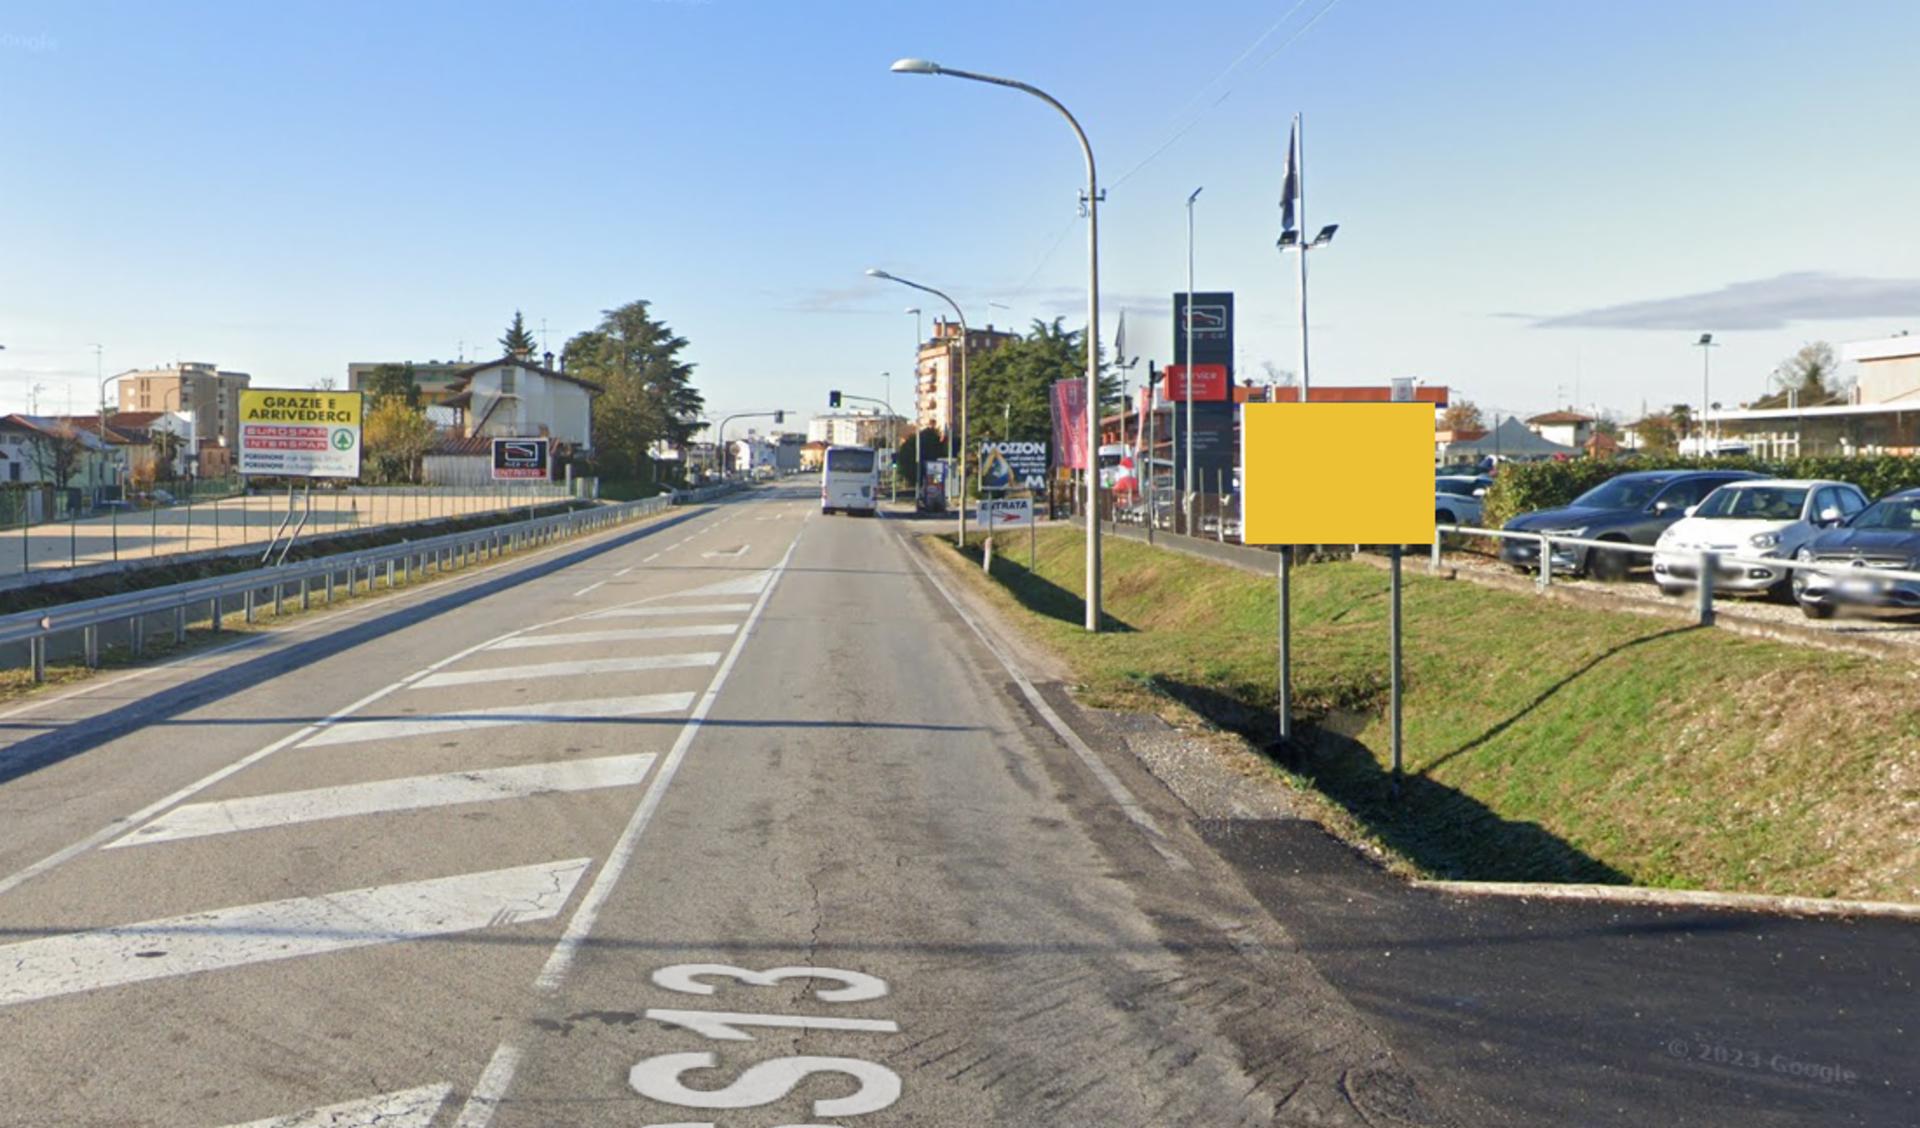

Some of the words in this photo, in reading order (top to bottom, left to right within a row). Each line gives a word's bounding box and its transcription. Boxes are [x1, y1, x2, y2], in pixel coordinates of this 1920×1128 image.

[263, 396, 322, 409] GRAZIE
[328, 398, 336, 410] E
[248, 409, 351, 423] ARRIVEDERCI
[246, 427, 327, 438] EUROSPAR
[245, 439, 327, 449] INTERSPAR
[981, 442, 1046, 455] MOZZON
